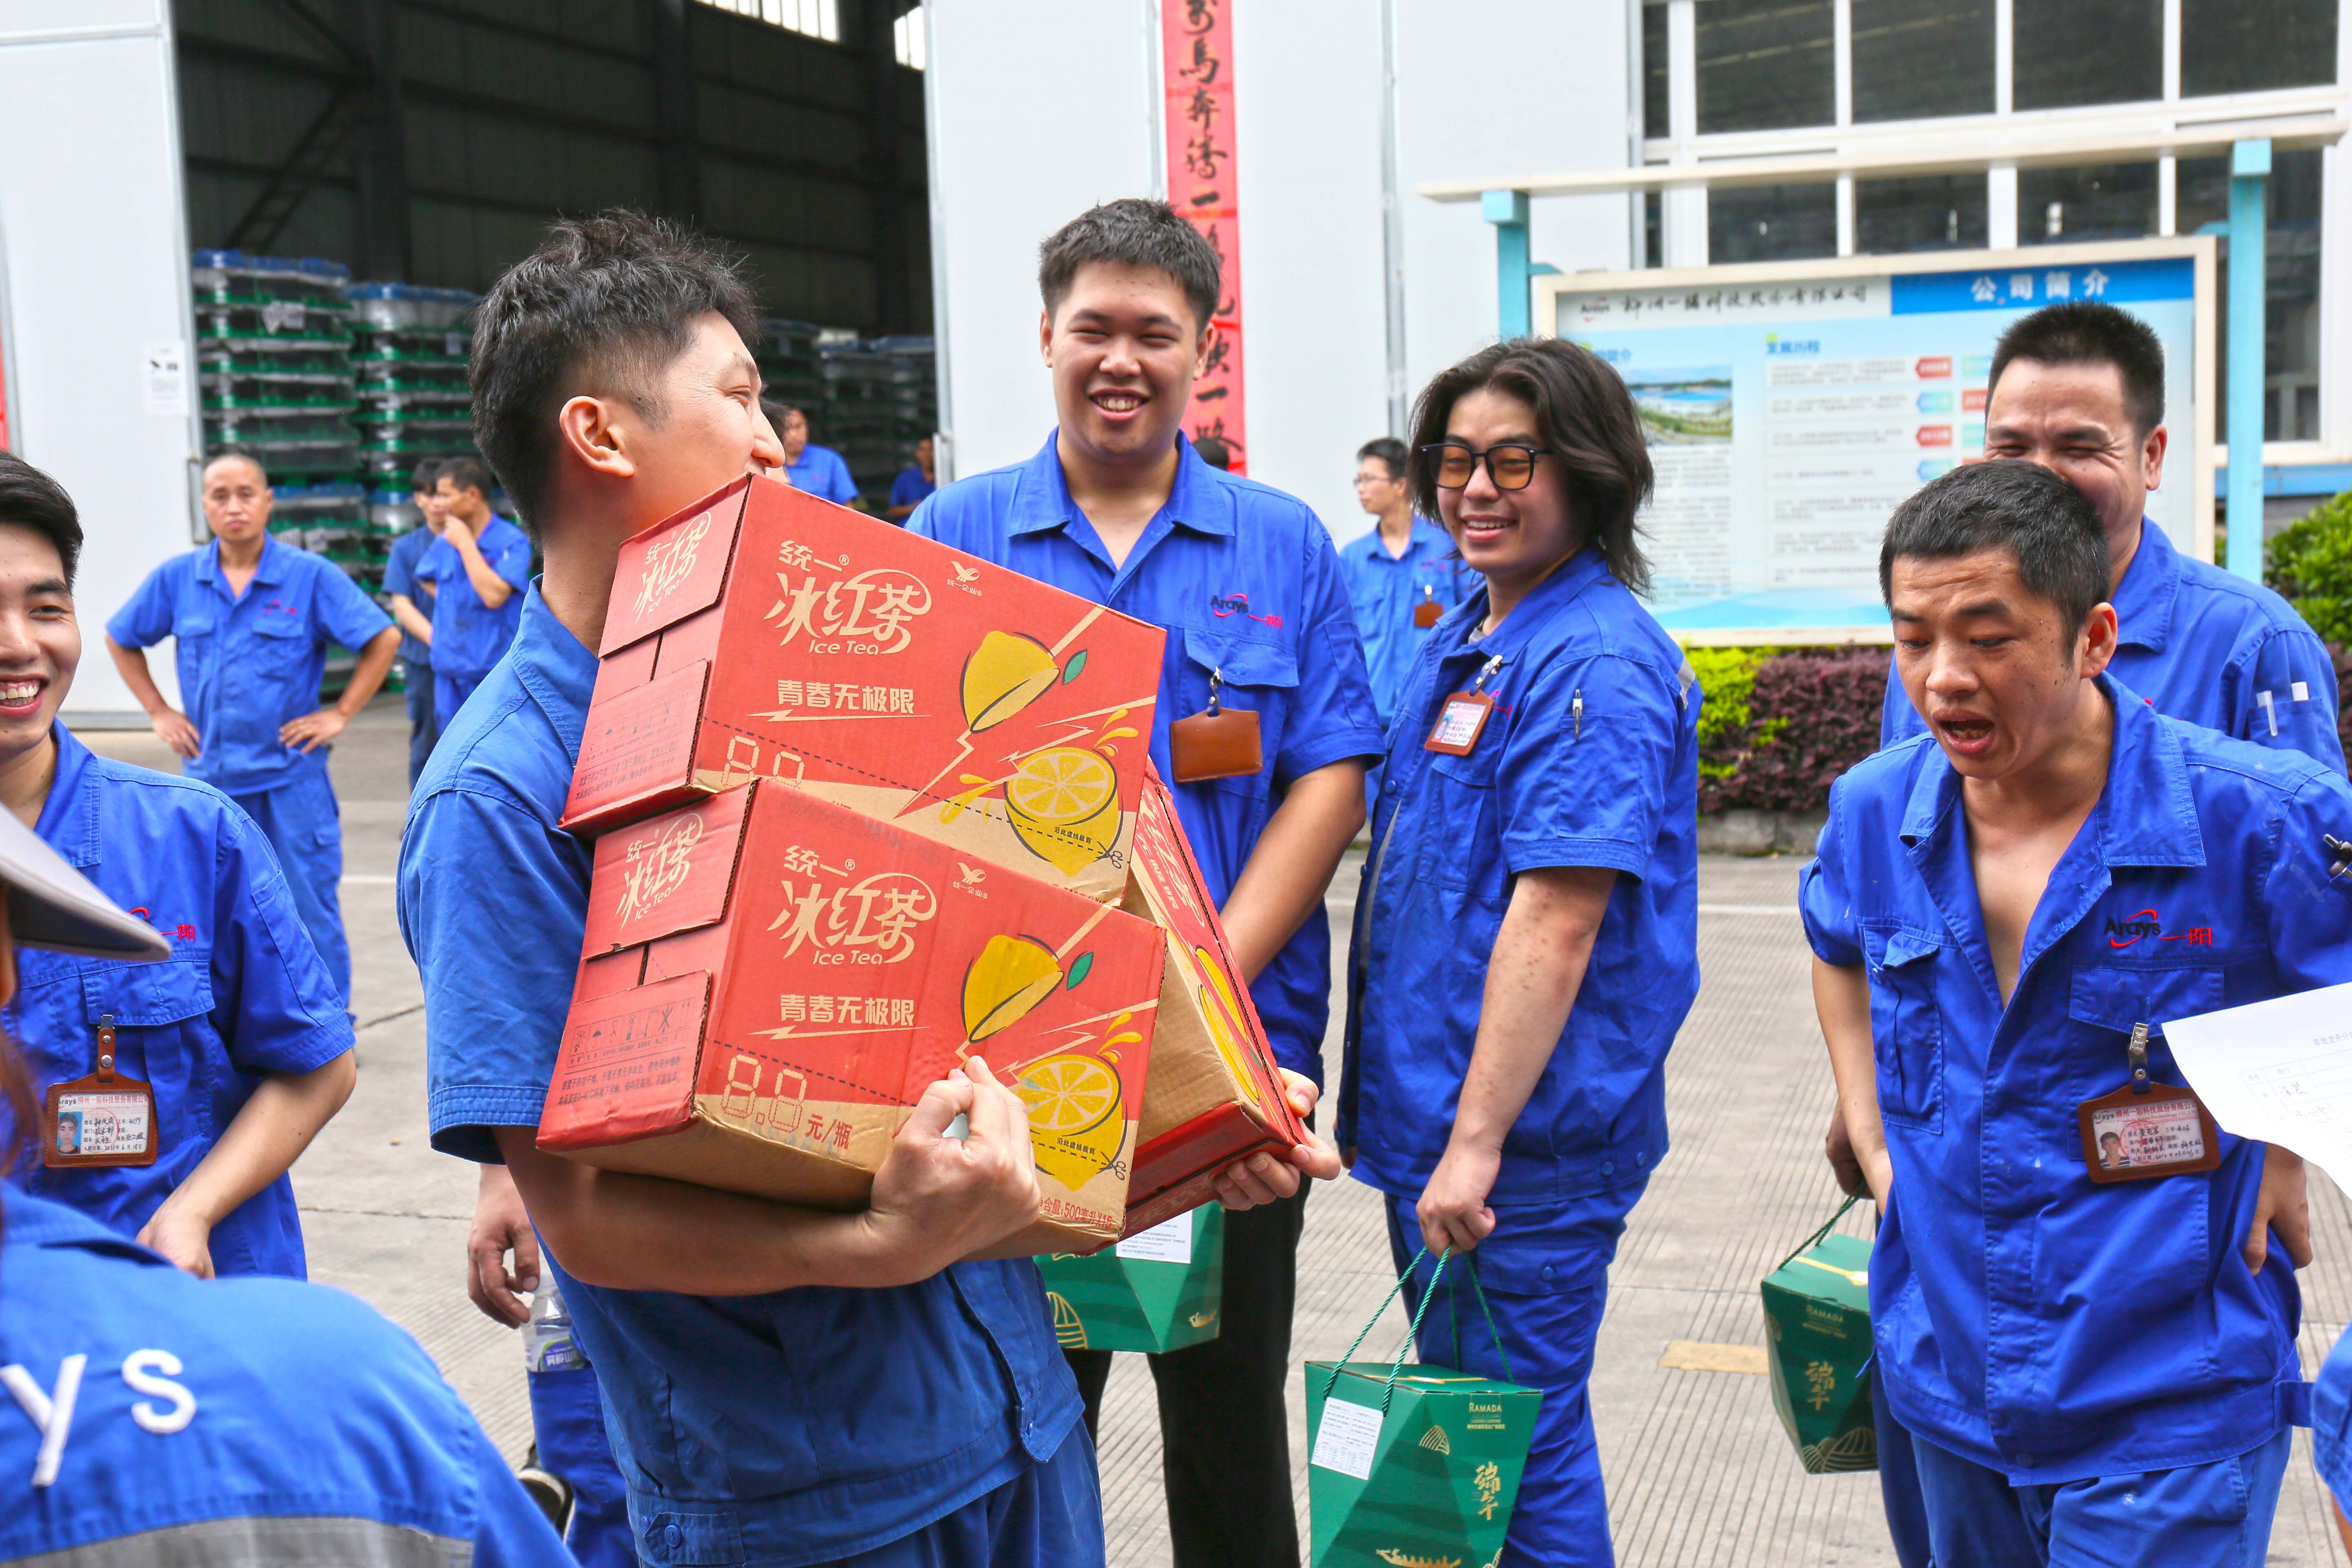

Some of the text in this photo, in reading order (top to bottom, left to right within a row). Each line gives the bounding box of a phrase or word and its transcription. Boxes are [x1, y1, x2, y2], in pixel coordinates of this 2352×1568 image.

[1971, 269, 2109, 302] 公司简介
[632, 511, 711, 624] 冰红茶
[763, 569, 931, 654] 冰红茶
[1211, 595, 1249, 613] Arays
[808, 640, 879, 655] Ice Tea
[777, 680, 914, 714] 青春无极限
[1054, 826, 1092, 844] 沿此虚线裁剪
[615, 813, 703, 929] 冰红茶
[635, 887, 671, 921] Ice Tea
[766, 873, 937, 964] 冰红茶
[2104, 918, 2161, 939] Arays
[813, 950, 883, 965] Ice Tea
[780, 994, 914, 1027] 青春无极限
[805, 1114, 853, 1150] 元/瓶
[1057, 1137, 1096, 1155] 沿此虚线裁剪
[1805, 1361, 1835, 1410] 端午
[1474, 1461, 1501, 1521] 端午
